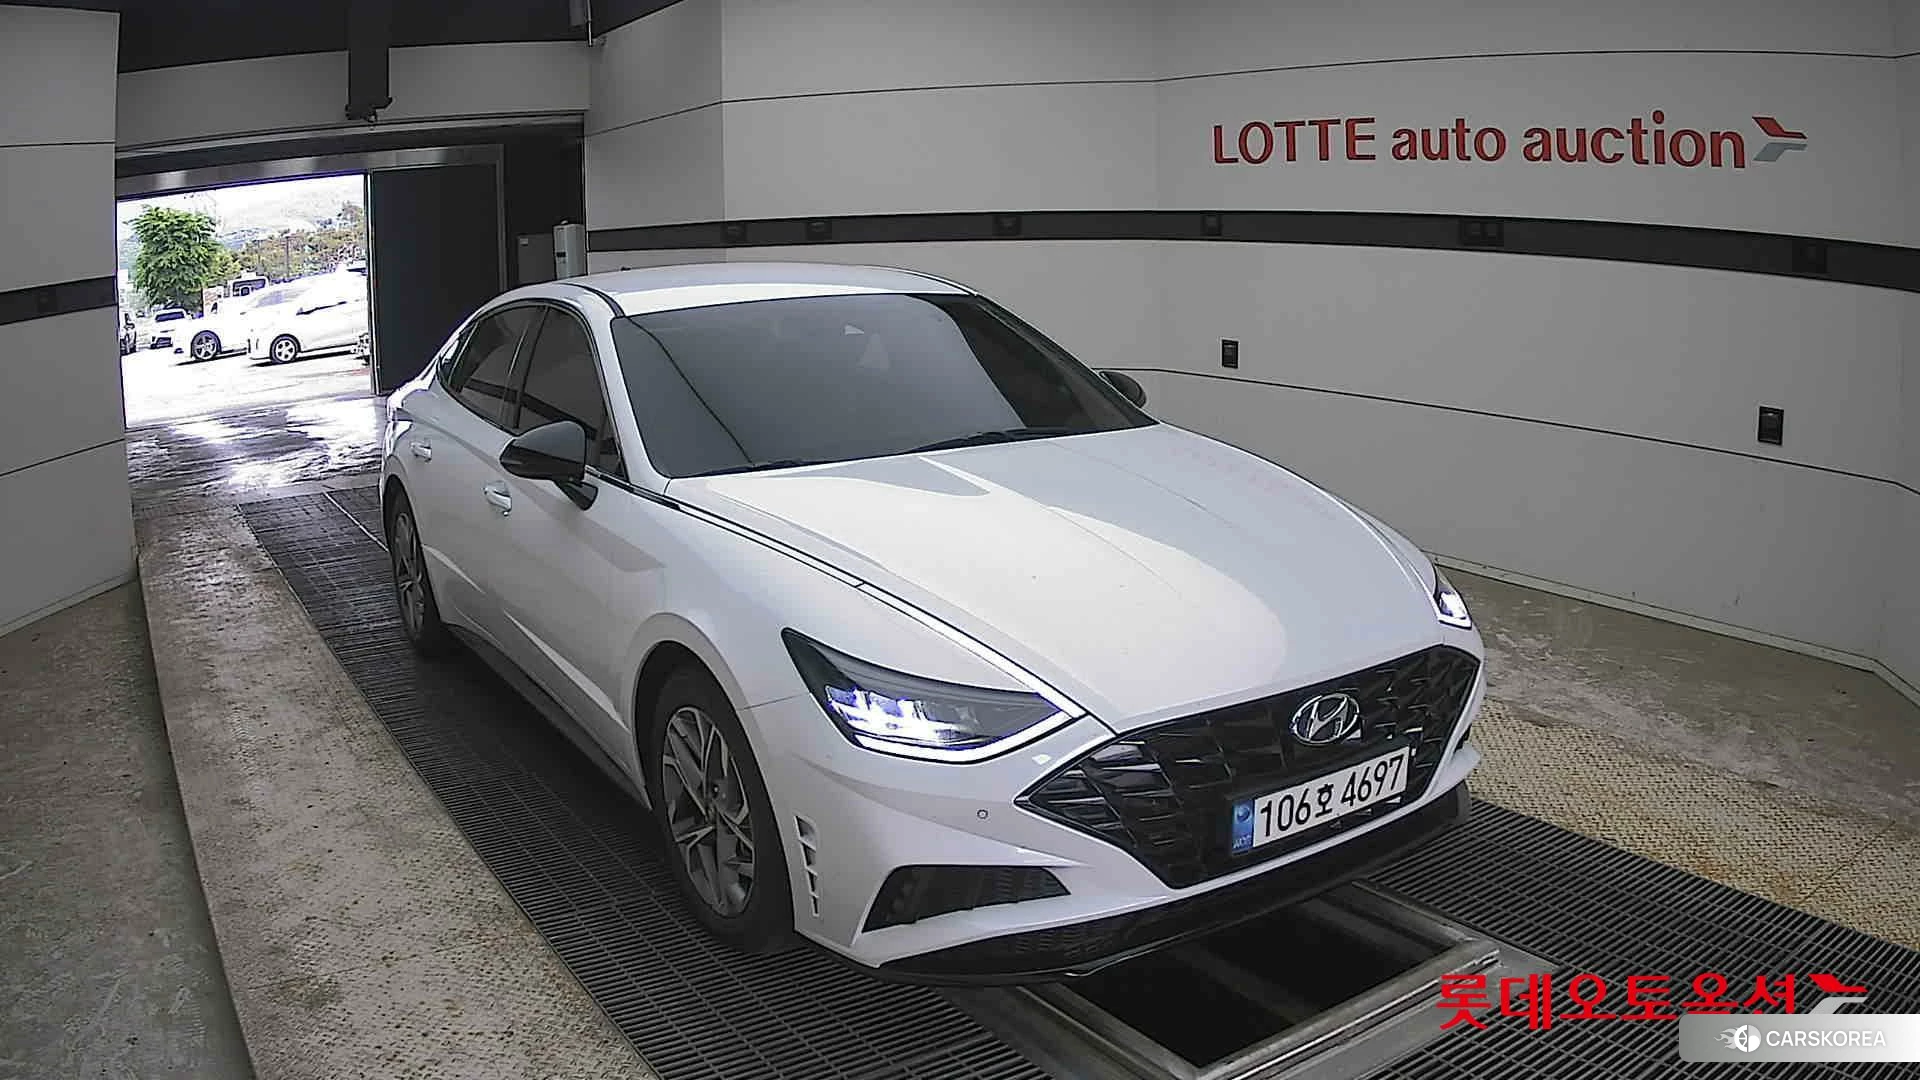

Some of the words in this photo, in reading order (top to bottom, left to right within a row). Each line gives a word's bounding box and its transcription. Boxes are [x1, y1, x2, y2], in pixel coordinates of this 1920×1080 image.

[1212, 117, 1377, 164] LOTTE
[1391, 117, 1508, 162] auto
[1522, 110, 1746, 169] auction
[1260, 782, 1334, 837] 106호
[1341, 753, 1405, 807] 4697
